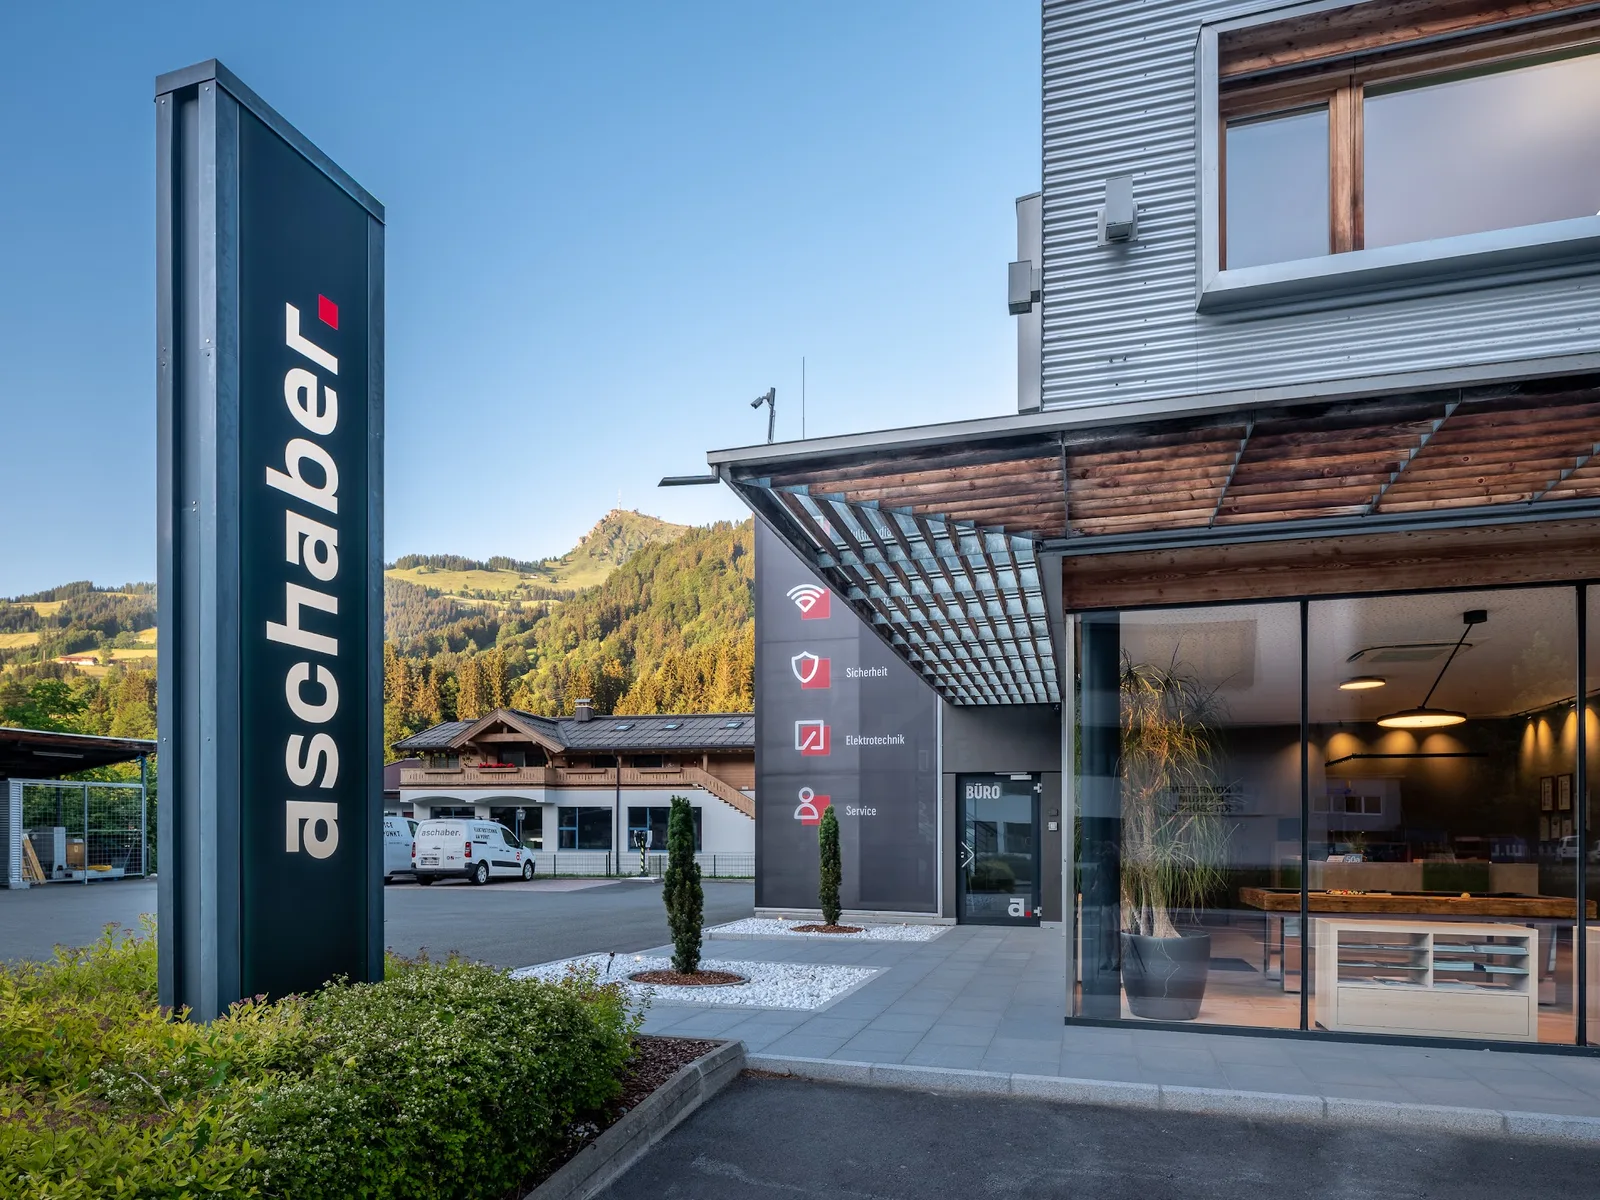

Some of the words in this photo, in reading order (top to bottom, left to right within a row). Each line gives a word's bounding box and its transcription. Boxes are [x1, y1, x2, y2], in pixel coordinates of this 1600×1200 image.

[846, 666, 888, 678] Sicherheit
[845, 733, 905, 746] Elektrotechnik
[965, 783, 1001, 799] BÜRO
[845, 805, 877, 816] Service
